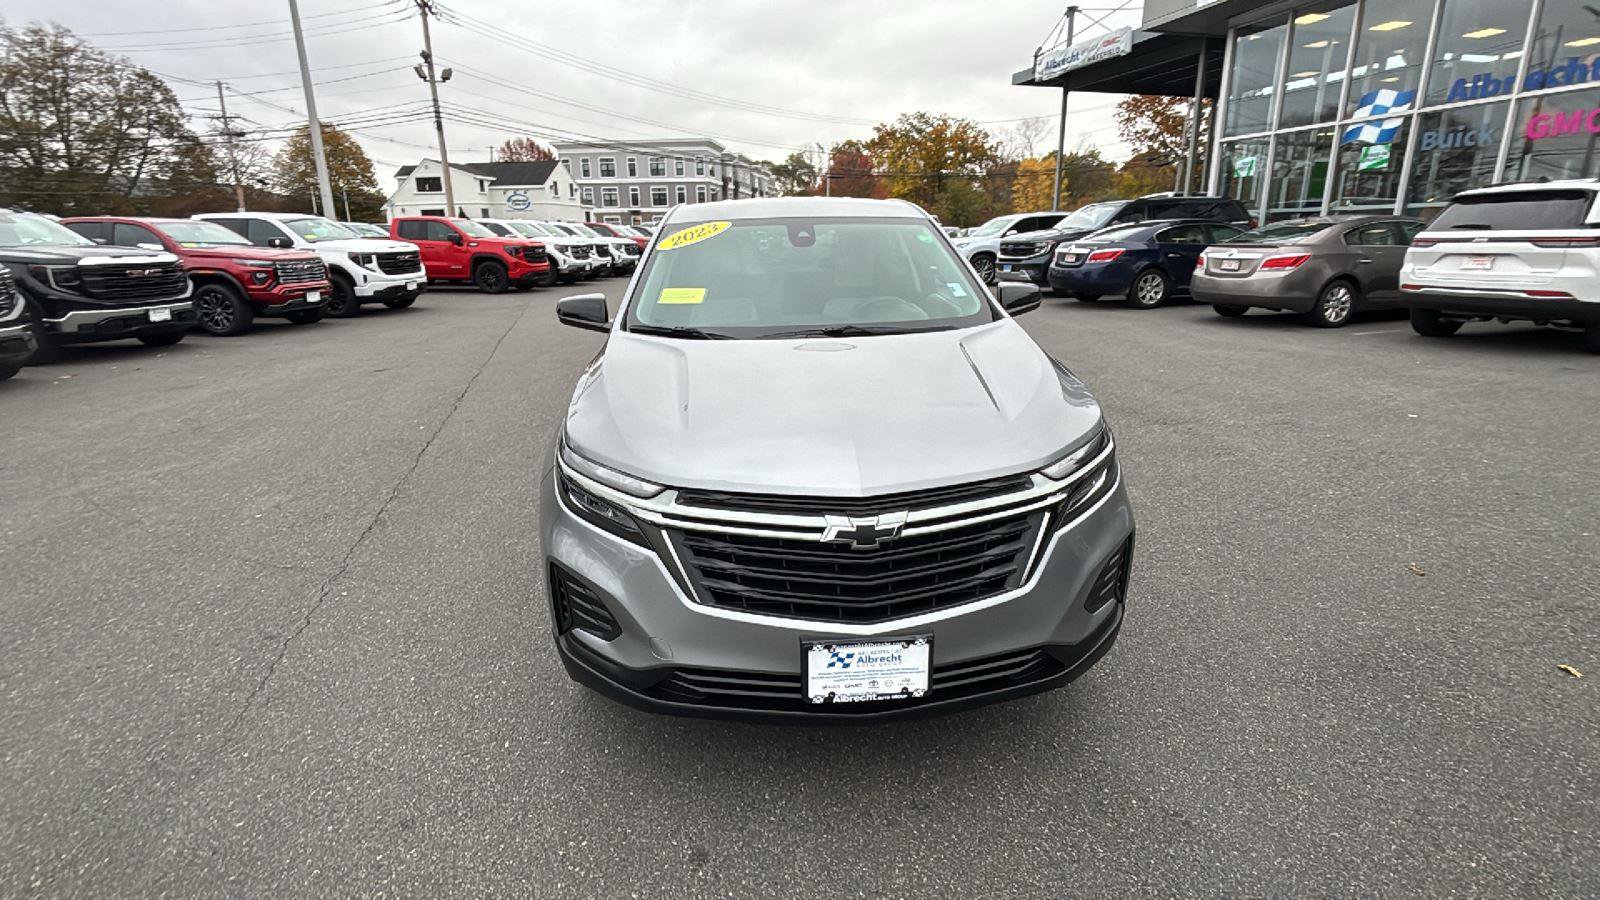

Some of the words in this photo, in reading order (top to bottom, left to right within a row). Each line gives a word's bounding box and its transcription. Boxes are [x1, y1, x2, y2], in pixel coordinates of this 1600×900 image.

[1447, 57, 1600, 102] Albrecht
[1526, 108, 1600, 140] GMC
[1420, 123, 1495, 152] Buick
[671, 223, 719, 247] 2023
[856, 653, 903, 664] Albrecht
[833, 692, 878, 704] Albrecht
